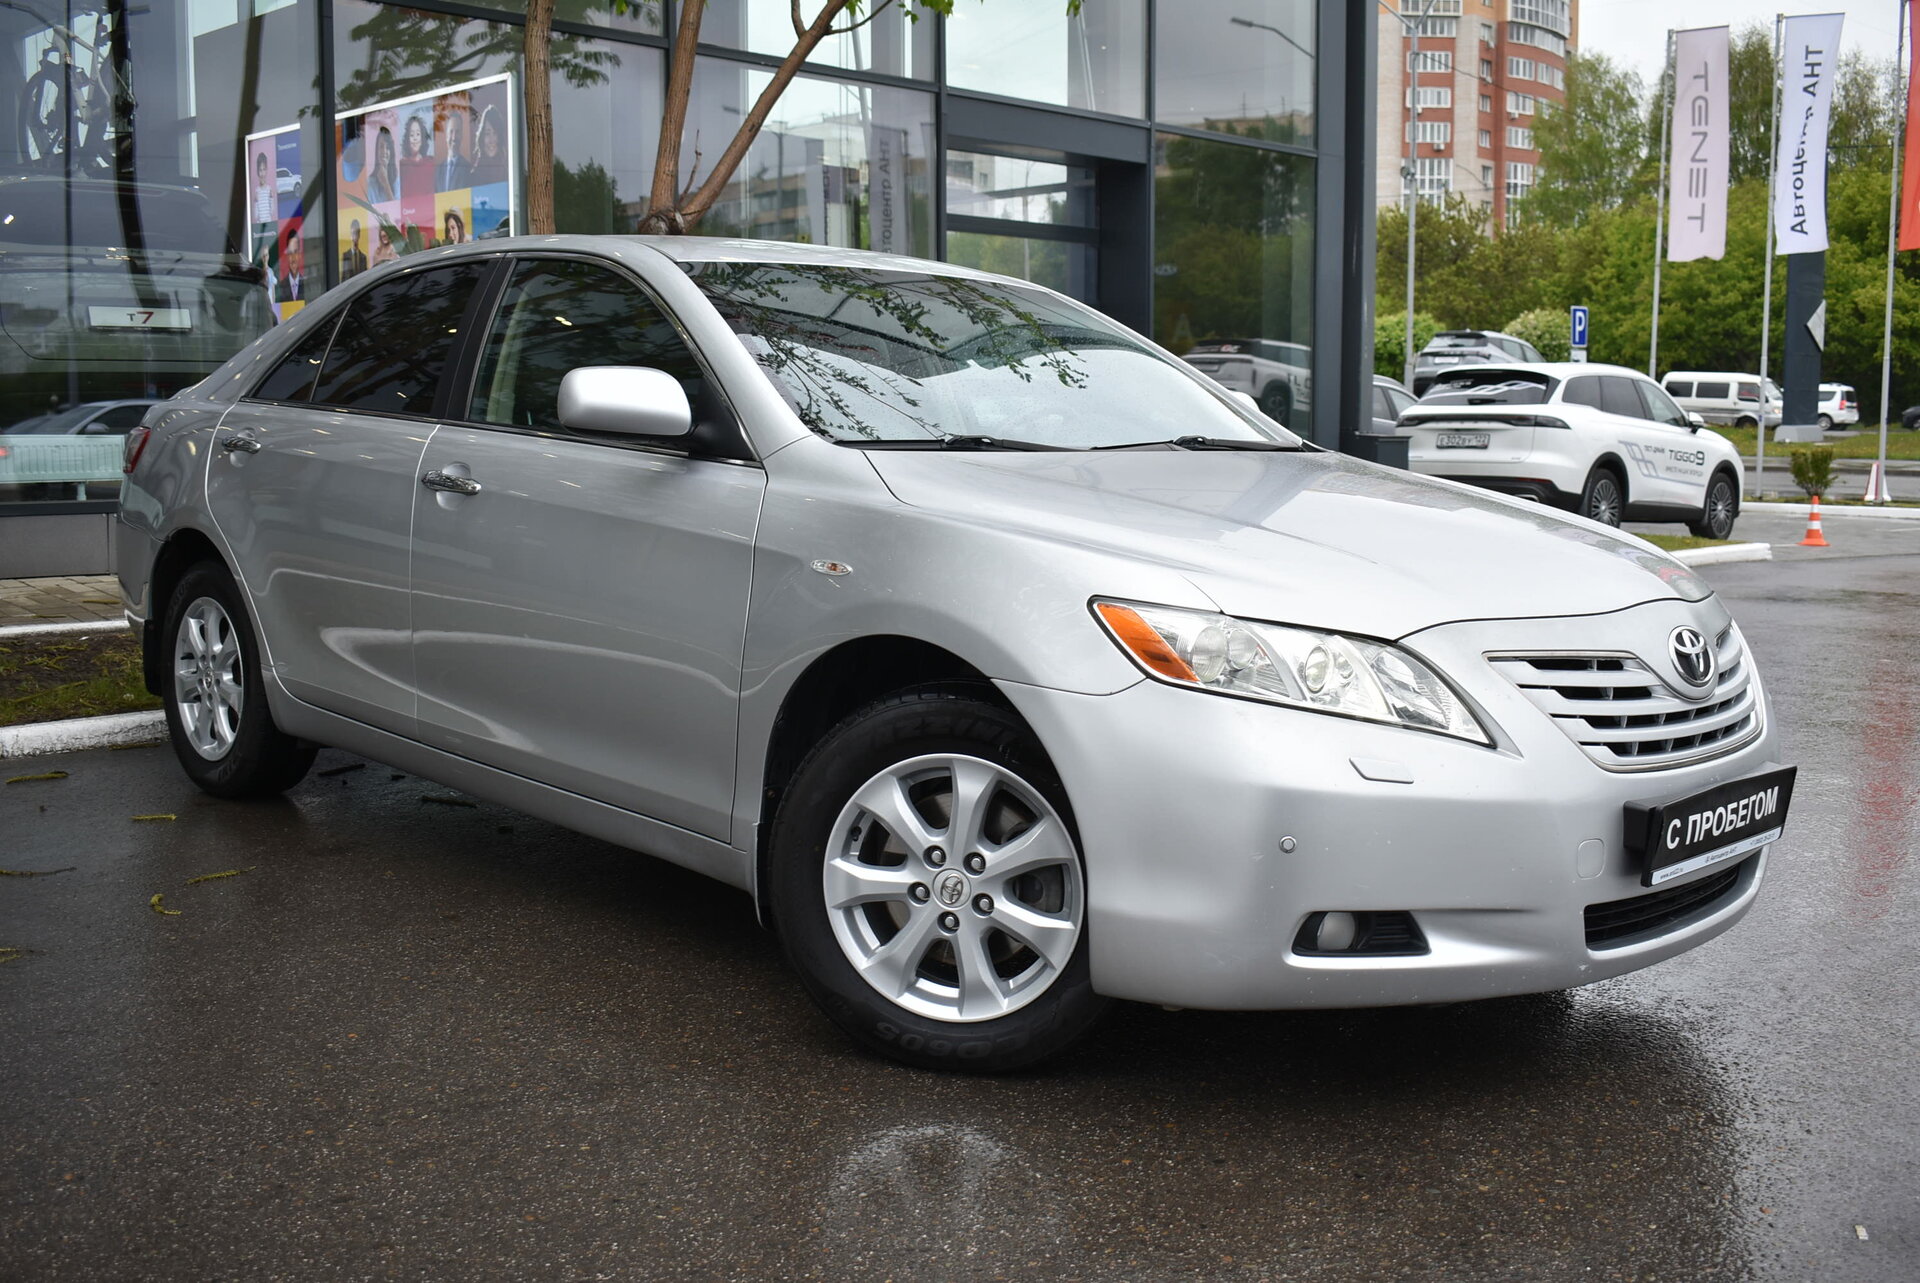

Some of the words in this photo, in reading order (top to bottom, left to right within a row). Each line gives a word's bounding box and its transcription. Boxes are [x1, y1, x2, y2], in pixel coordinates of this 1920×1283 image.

[1802, 44, 1824, 98] АНТ
[879, 138, 891, 175] АНТ
[1687, 60, 1709, 234] TENET
[1574, 311, 1586, 343] P
[1666, 818, 1682, 850] С
[1685, 786, 1779, 845] ПРОБЕГОМ
